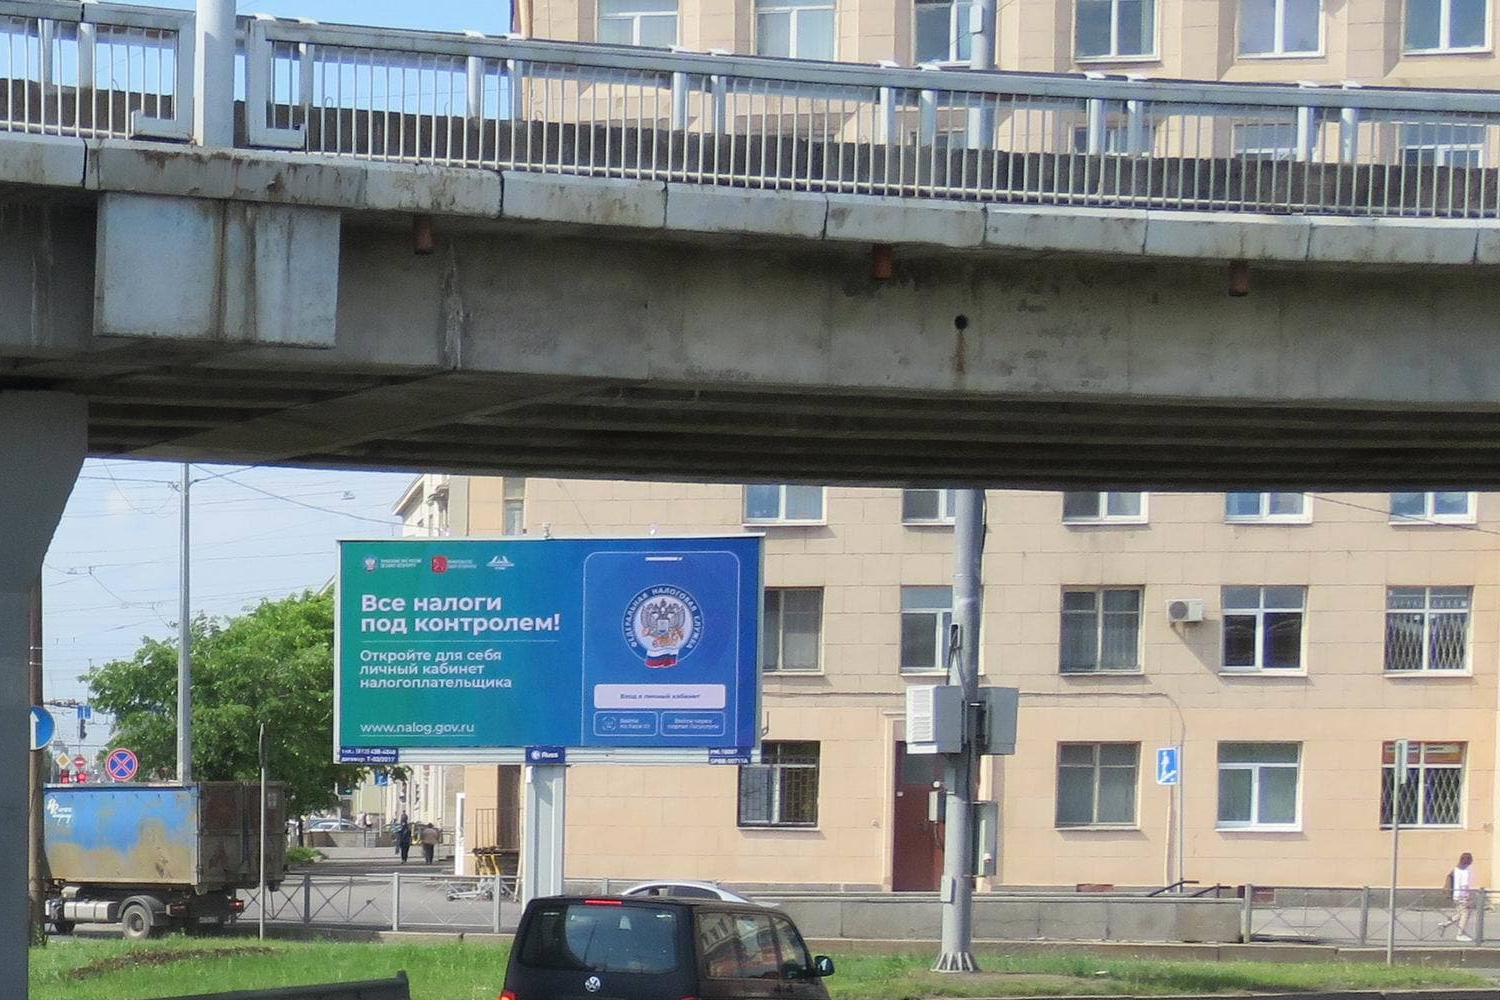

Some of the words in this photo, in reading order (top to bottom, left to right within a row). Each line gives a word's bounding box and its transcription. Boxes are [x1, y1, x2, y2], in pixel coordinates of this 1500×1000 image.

[361, 594, 406, 612] Все
[413, 595, 502, 612] налоги
[361, 616, 407, 634] под
[415, 613, 560, 636] контролем!
[360, 648, 431, 663] Откройте
[435, 650, 463, 662] для
[466, 648, 502, 661] себя
[359, 662, 418, 675] личный
[422, 662, 485, 675] кабинет
[359, 677, 512, 690] налогоплательщика
[360, 721, 475, 735] www.nalog.gov.ru
